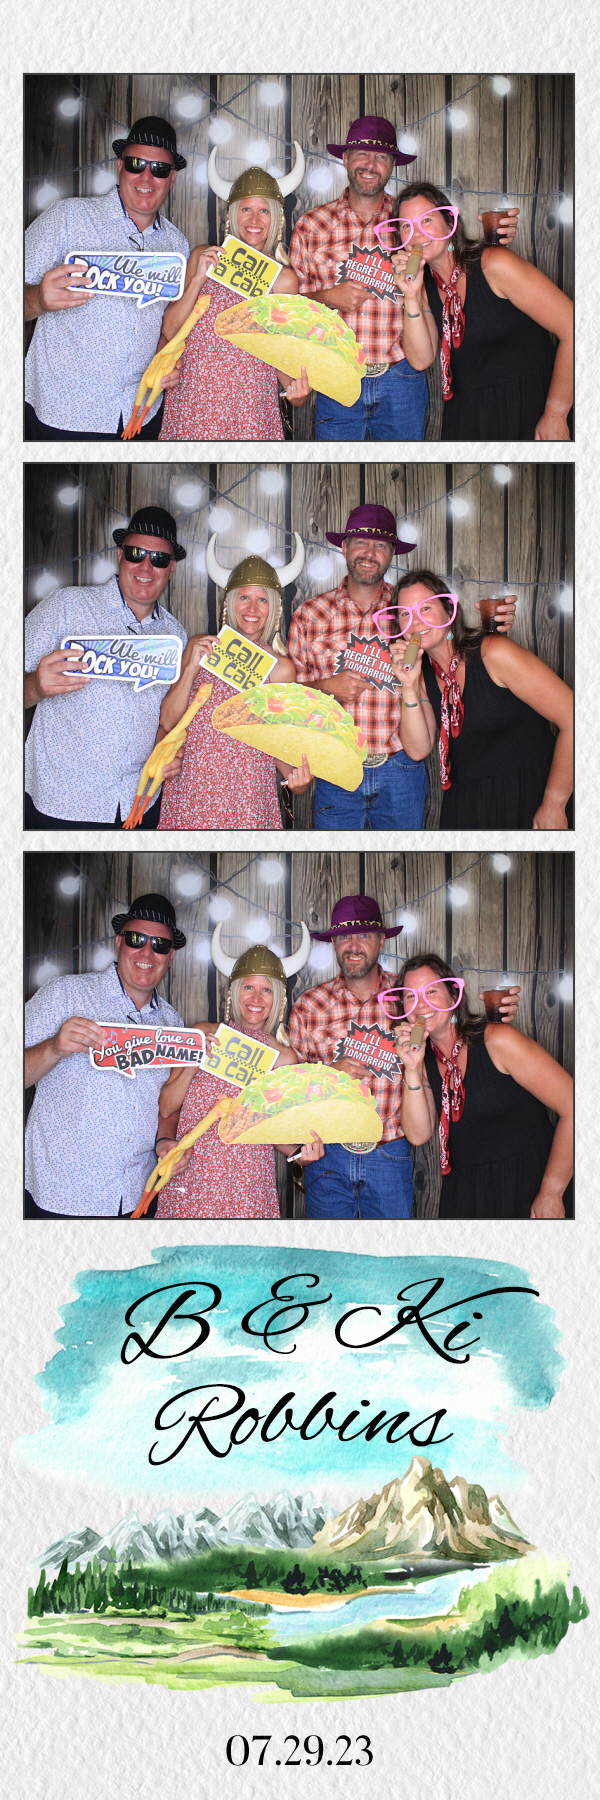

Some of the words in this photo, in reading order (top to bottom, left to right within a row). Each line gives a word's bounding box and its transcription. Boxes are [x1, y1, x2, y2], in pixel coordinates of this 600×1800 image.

[114, 255, 144, 277] We
[148, 266, 181, 283] will
[231, 247, 269, 278] Call
[345, 259, 379, 277] REGRET
[380, 271, 396, 284] THI
[365, 254, 382, 269] I'LL
[121, 276, 164, 297] YOU!
[213, 263, 227, 277] a
[230, 271, 263, 297] Cab
[345, 270, 395, 293] TOMORROW
[110, 639, 141, 660] We
[144, 649, 178, 666] will
[207, 652, 221, 667] a
[226, 638, 264, 671] Call
[343, 649, 377, 667] REGRET
[378, 660, 394, 674] THI
[363, 644, 381, 658] I'LL
[118, 660, 160, 680] YOU!
[343, 660, 393, 683] TOMORROW
[92, 1045, 123, 1062] You
[124, 1035, 153, 1056] give
[155, 1028, 183, 1043] love
[185, 1036, 196, 1045] a
[225, 1036, 265, 1067] Call
[343, 1037, 377, 1055] REGRET
[377, 1048, 398, 1063] THIS
[362, 1032, 380, 1047] I'LL
[114, 1049, 155, 1070] BAD
[155, 1044, 204, 1063] NAME!
[207, 1054, 221, 1069] a
[343, 1047, 392, 1071] TOMORROW
